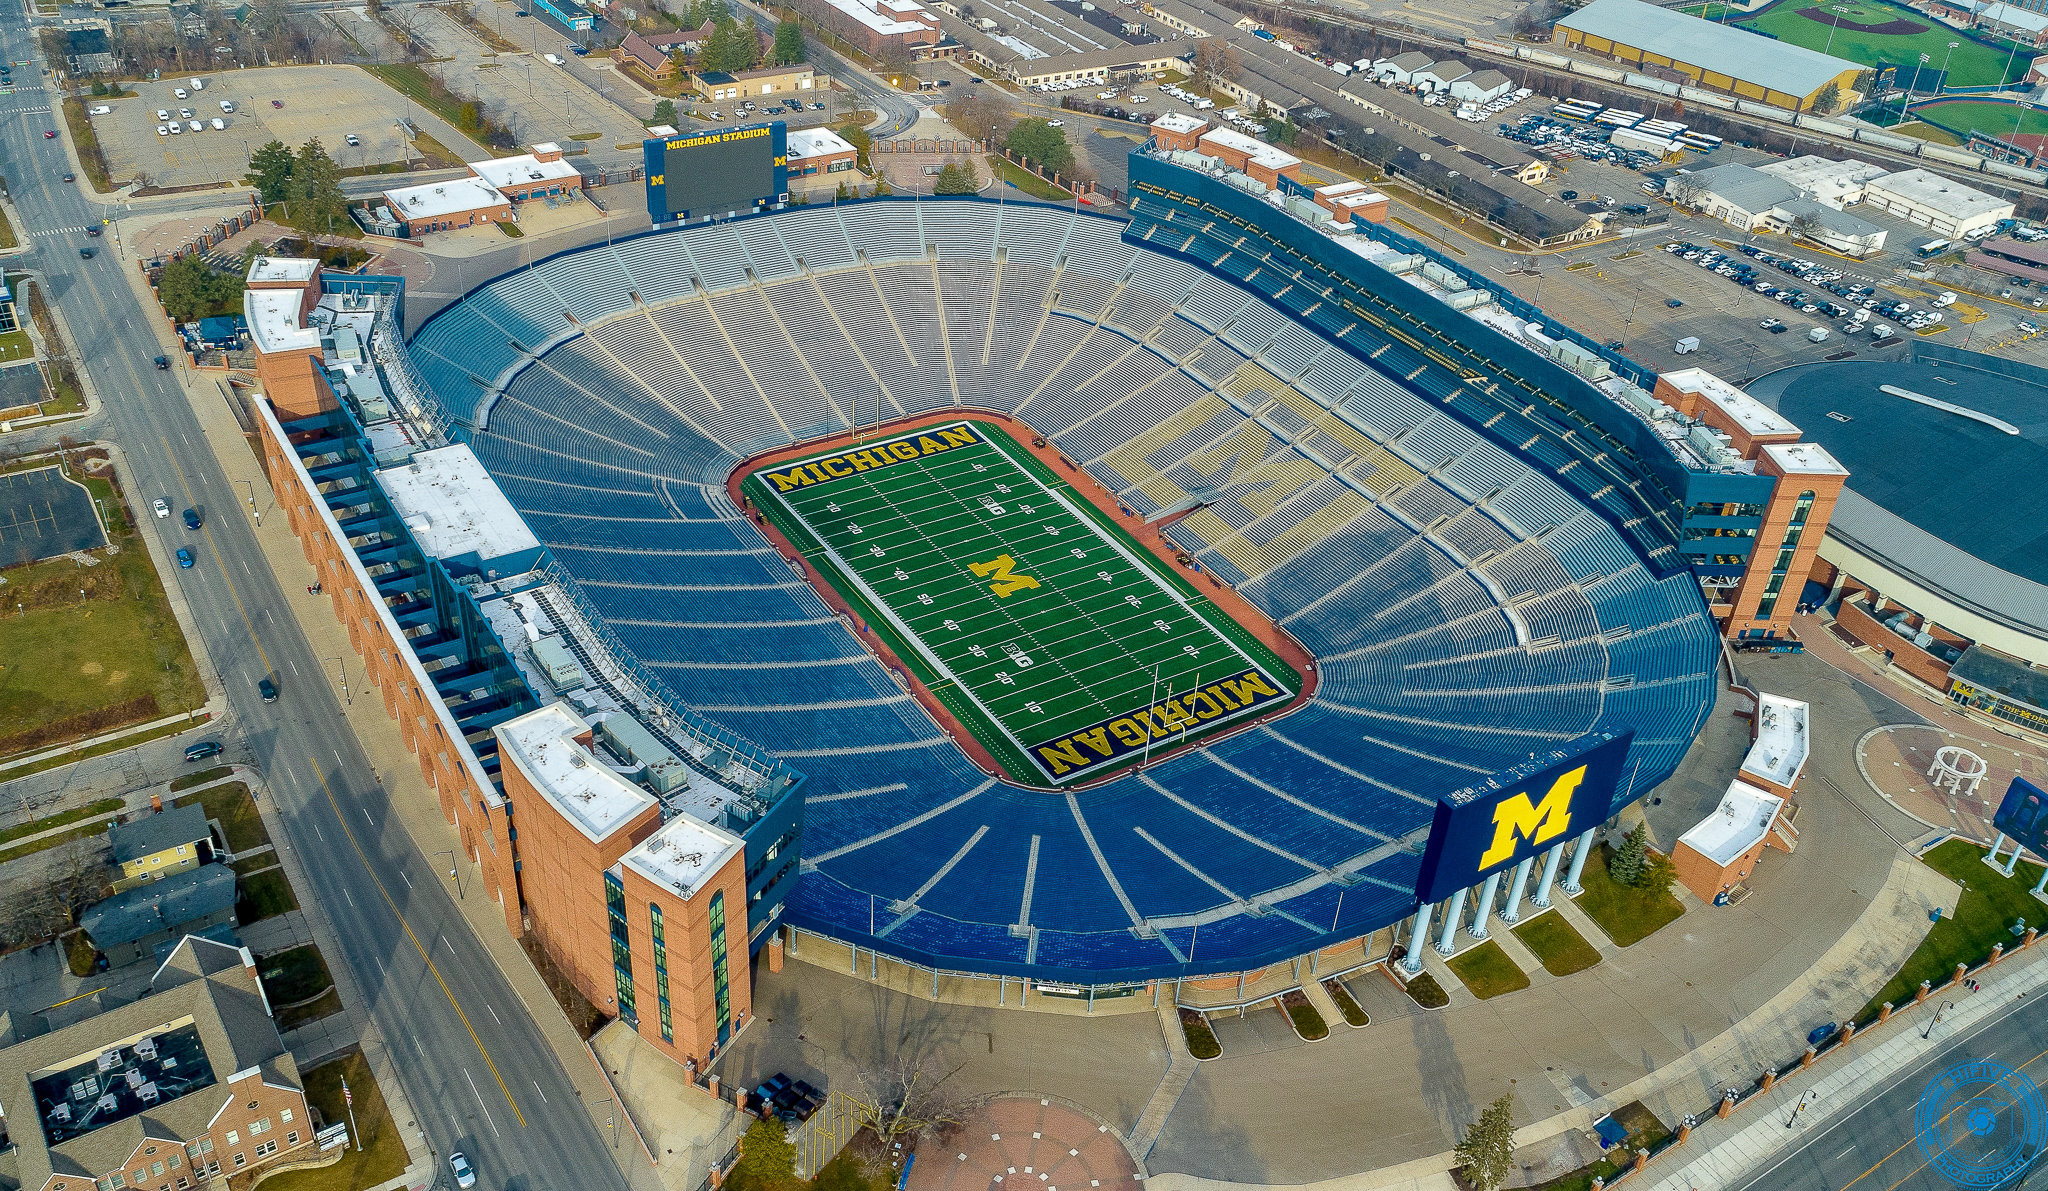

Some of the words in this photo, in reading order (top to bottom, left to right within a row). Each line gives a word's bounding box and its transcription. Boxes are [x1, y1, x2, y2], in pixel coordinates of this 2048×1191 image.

[666, 134, 721, 151] MICHIGAN
[722, 127, 771, 142] STADIUM
[773, 156, 787, 167] M
[650, 174, 665, 186] M
[767, 426, 979, 492] MICHIGAN
[967, 554, 1042, 599] M
[917, 593, 934, 605] 50
[943, 619, 960, 631] 40
[967, 644, 986, 657] 30
[994, 671, 1013, 685] 20
[1024, 701, 1042, 713] 10
[1038, 671, 1280, 775] MICHIGAN
[1478, 764, 1587, 872] M
